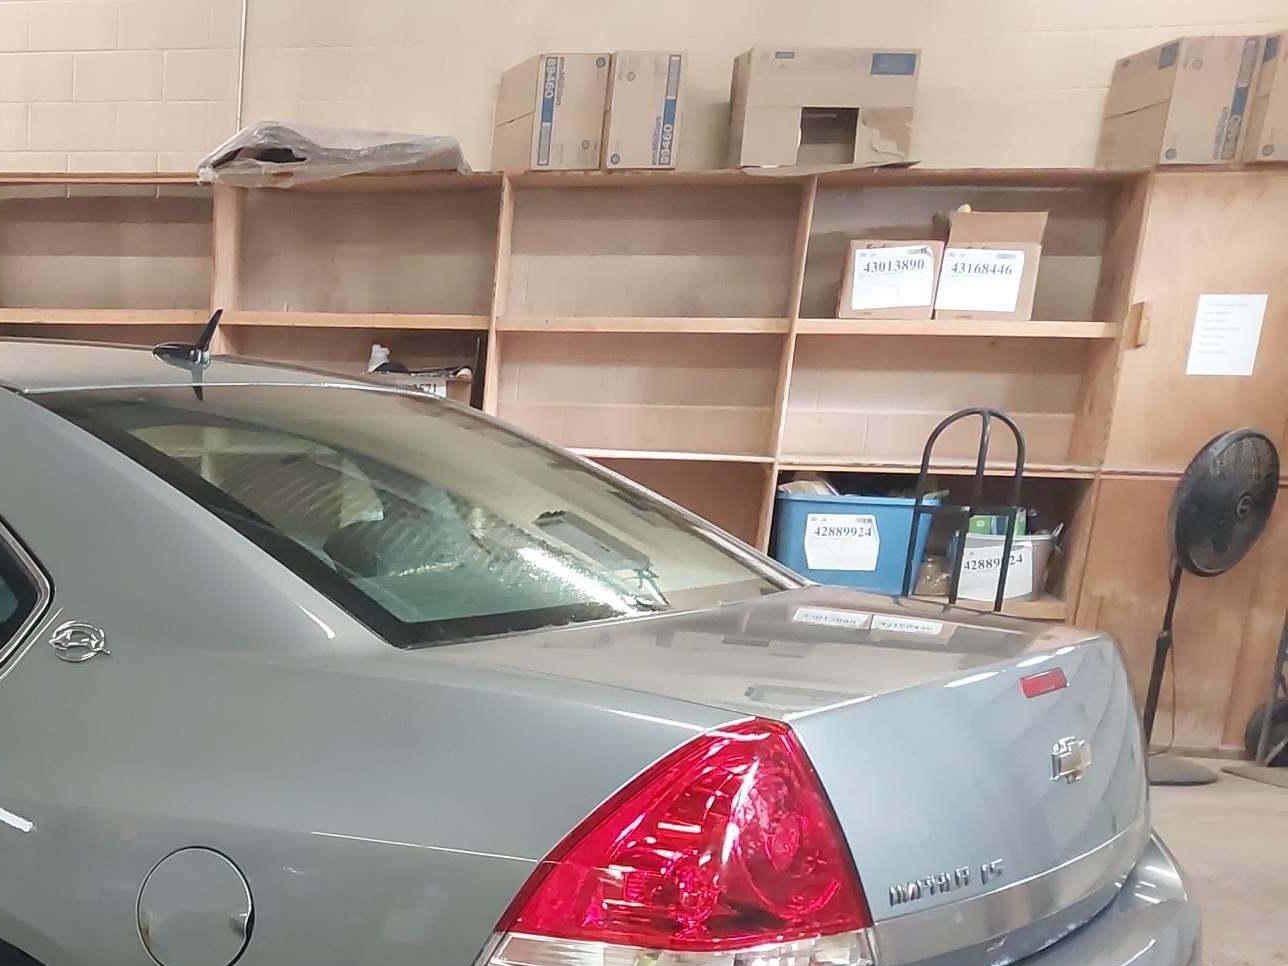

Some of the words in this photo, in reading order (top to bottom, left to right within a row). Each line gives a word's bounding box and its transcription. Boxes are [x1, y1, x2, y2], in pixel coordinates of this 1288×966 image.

[863, 258, 925, 273] 43013890
[951, 262, 1013, 275] 43168446
[813, 526, 872, 537] 42889924
[964, 553, 1023, 571] 4288924
